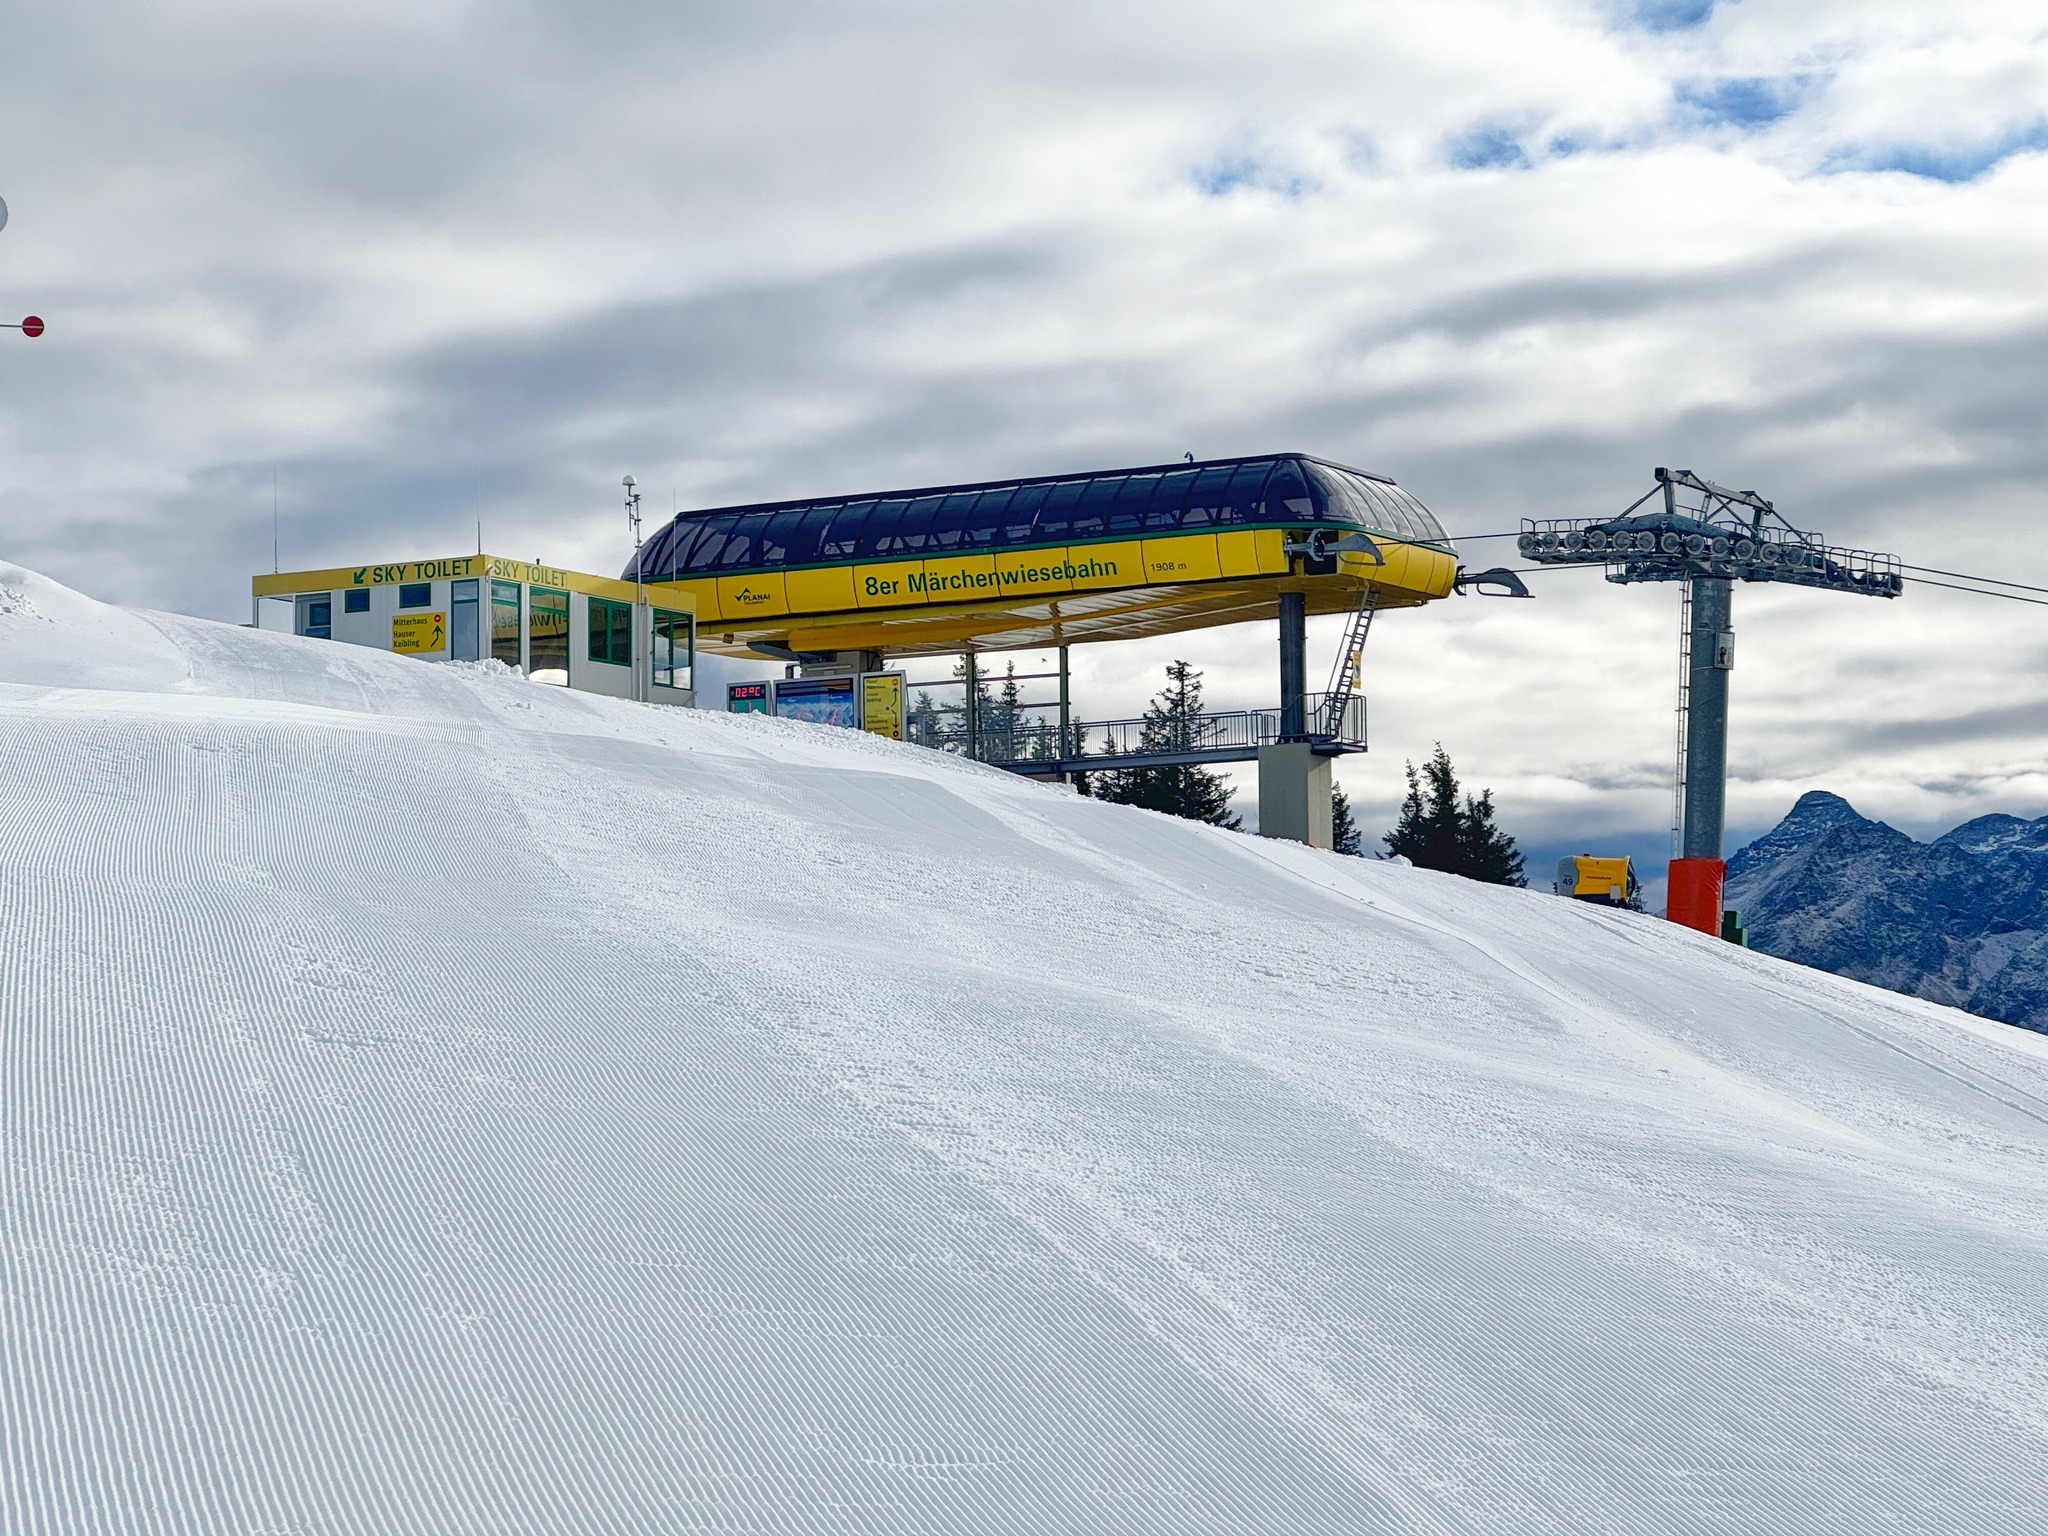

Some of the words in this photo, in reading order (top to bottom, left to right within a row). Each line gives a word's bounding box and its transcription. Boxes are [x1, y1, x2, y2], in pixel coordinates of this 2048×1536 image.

[373, 565, 407, 583] SKY
[414, 559, 472, 579] TOILET
[1150, 561, 1175, 572] 1908
[1177, 562, 1187, 570] m
[494, 559, 519, 578] SKY
[524, 564, 567, 588] TOILET
[865, 576, 899, 596] 8er
[907, 558, 1118, 593] Märchenwiesebahn
[743, 593, 771, 602] PLANAI
[393, 617, 428, 627] Mitterhaus
[393, 630, 416, 639] Hauser
[393, 639, 420, 648] Kaibling
